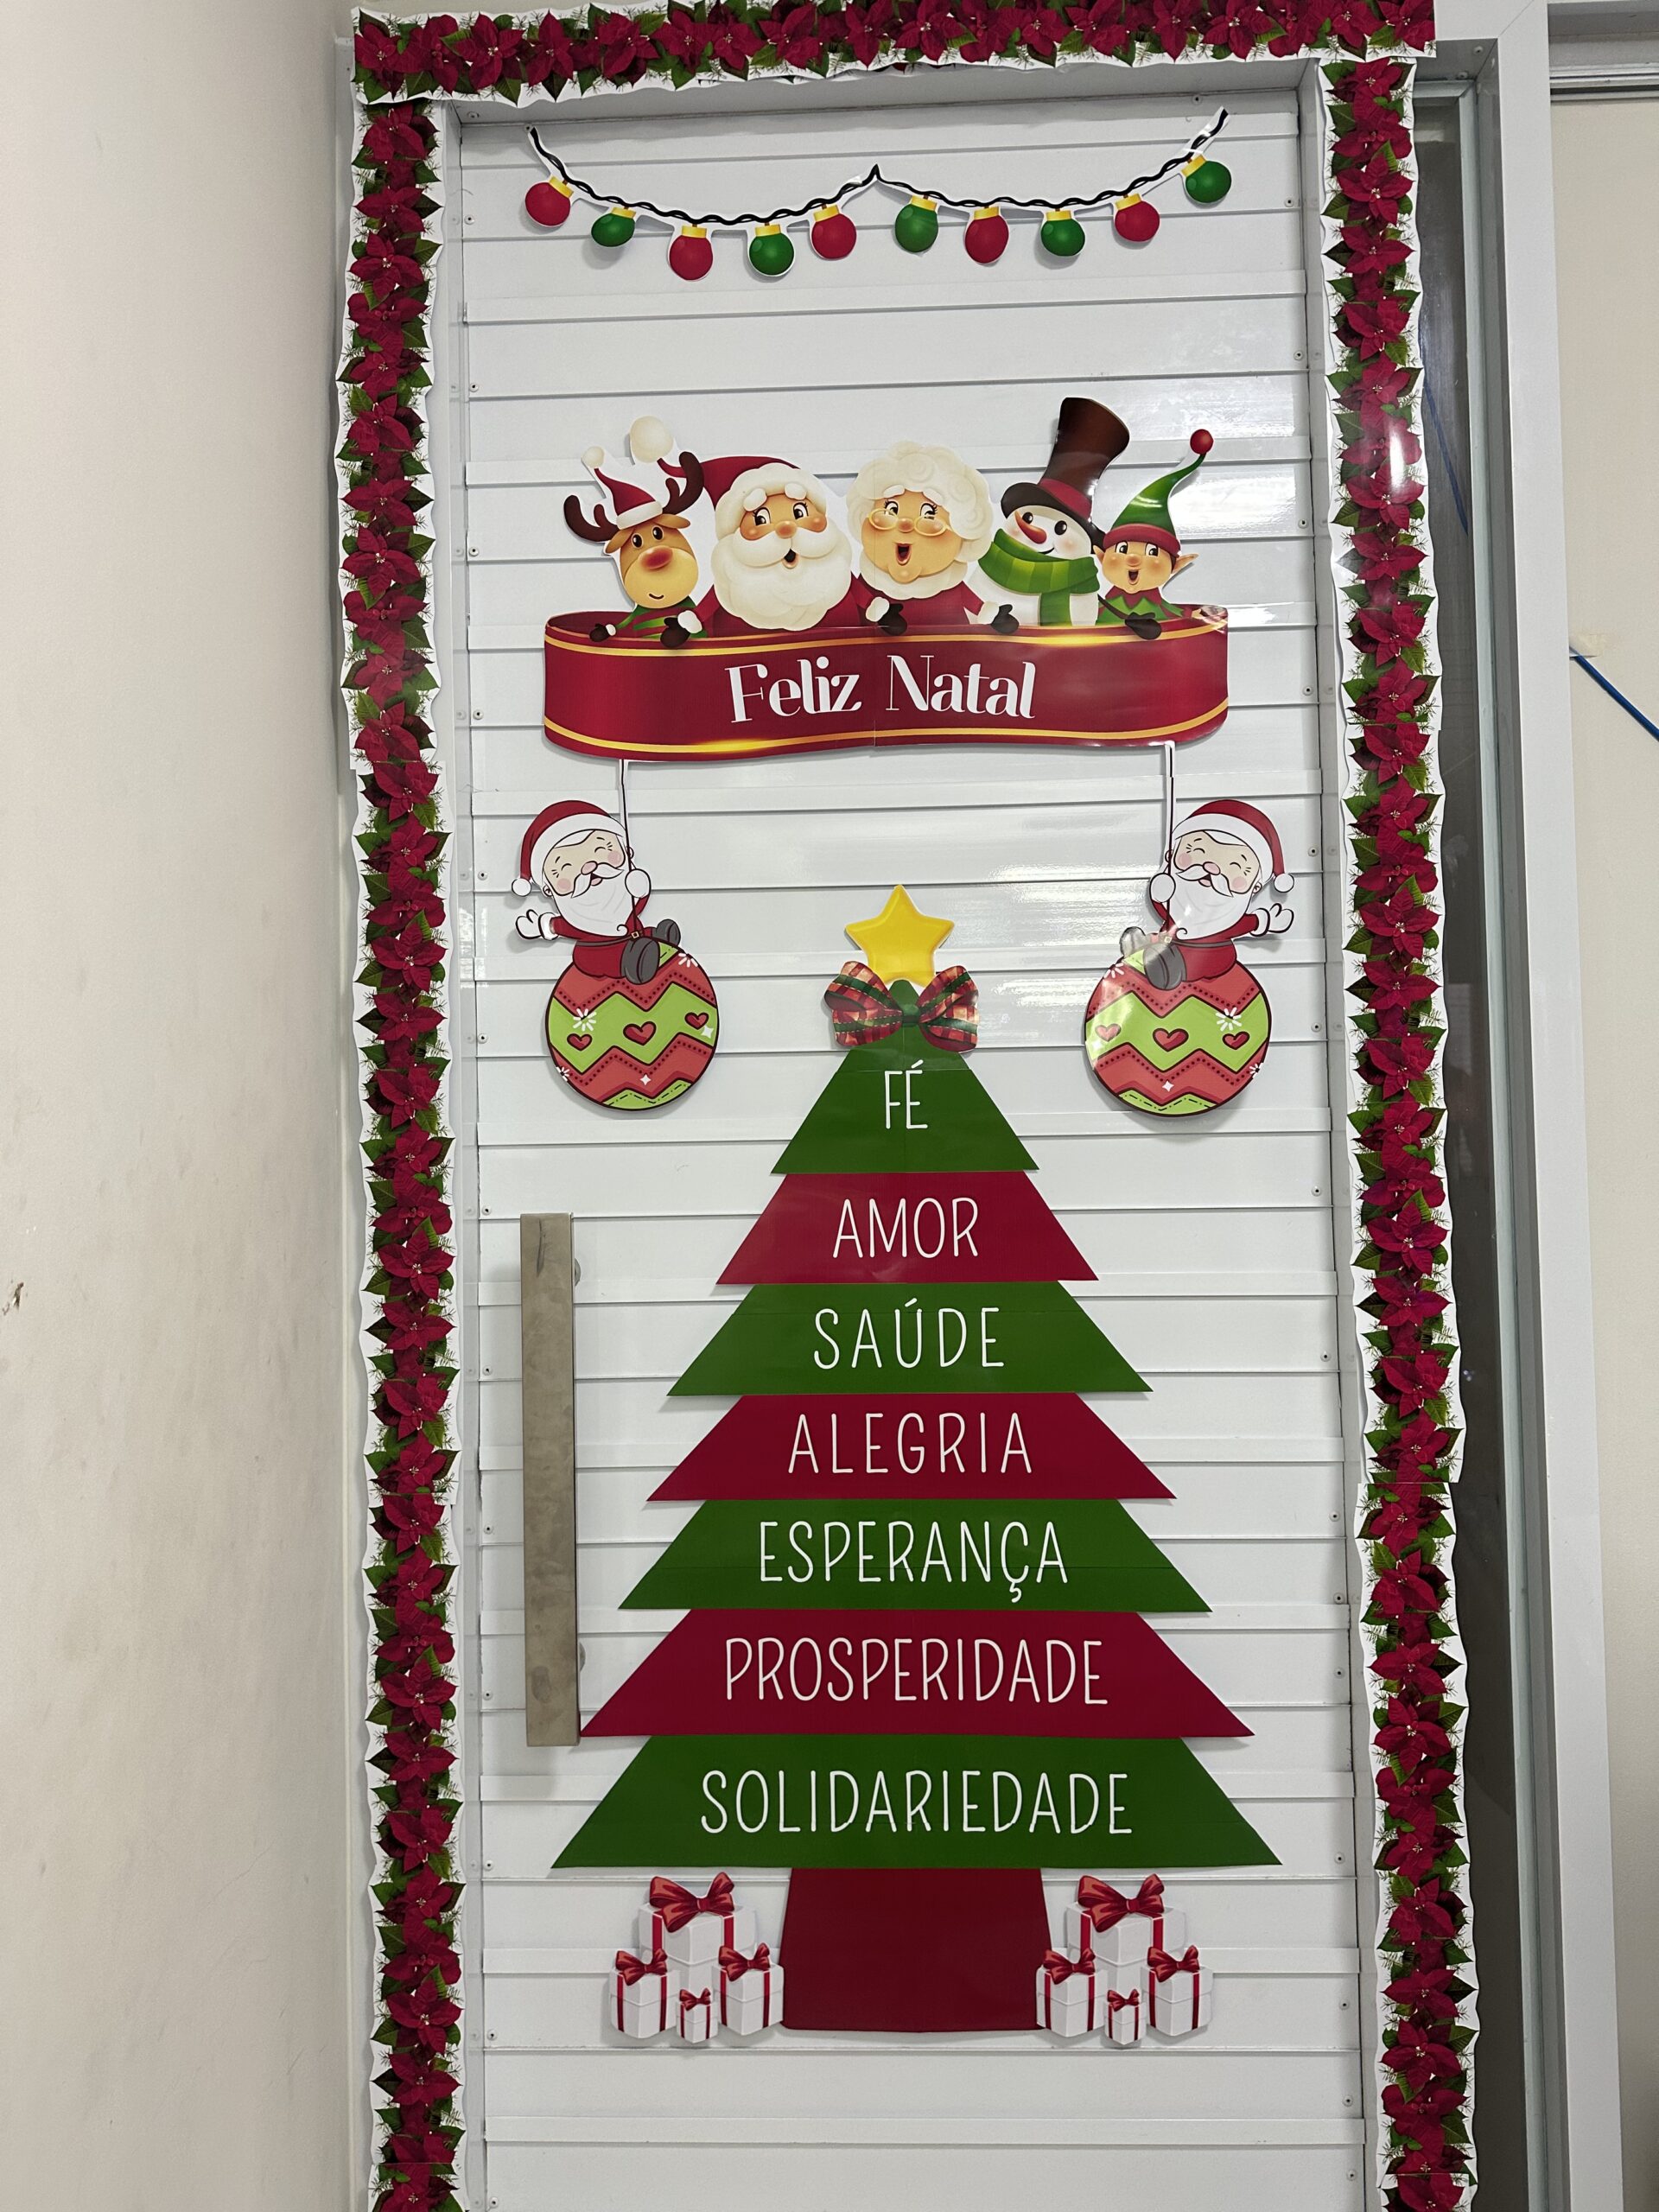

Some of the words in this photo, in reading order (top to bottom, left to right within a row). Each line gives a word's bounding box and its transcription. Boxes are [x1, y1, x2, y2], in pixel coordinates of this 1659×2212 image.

[724, 656, 862, 723] Feliz
[885, 655, 1036, 719] Natal
[884, 1058, 928, 1129] FÉ
[832, 1197, 978, 1259] AMOR
[813, 1297, 1005, 1370] SAÚDE
[788, 1412, 1032, 1474] ALEGRIA
[760, 1520, 1068, 1604] ESPERANÇA
[726, 1637, 1108, 1705] PROSPERIDADE
[701, 1770, 1133, 1834] SOLIDARIEDADE
